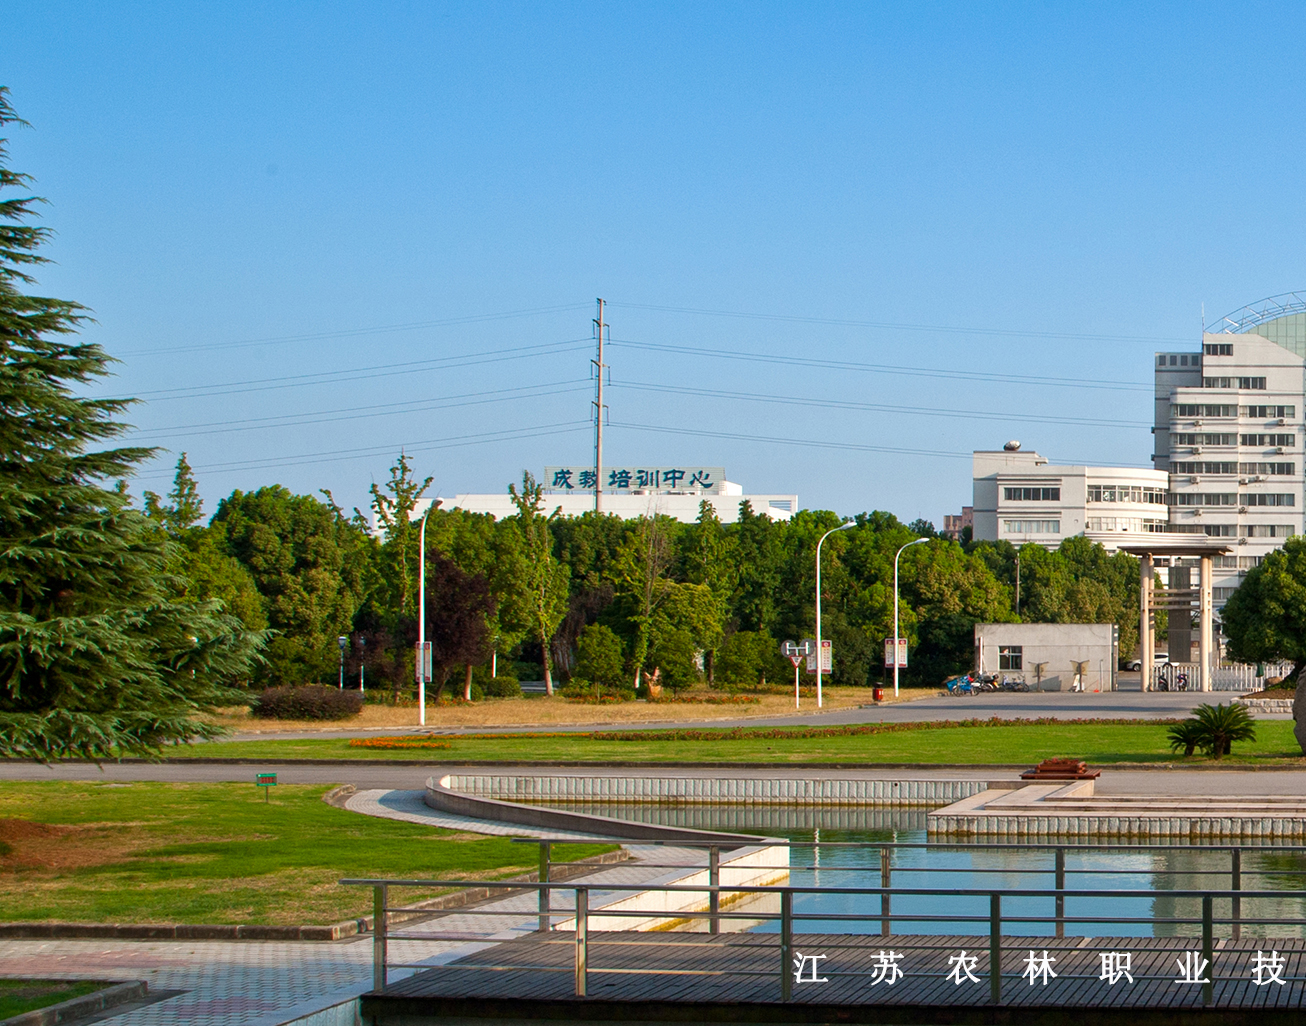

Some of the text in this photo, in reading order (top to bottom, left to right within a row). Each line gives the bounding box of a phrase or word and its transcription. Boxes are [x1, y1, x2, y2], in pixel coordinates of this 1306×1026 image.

[552, 469, 714, 489] 成教培训中心
